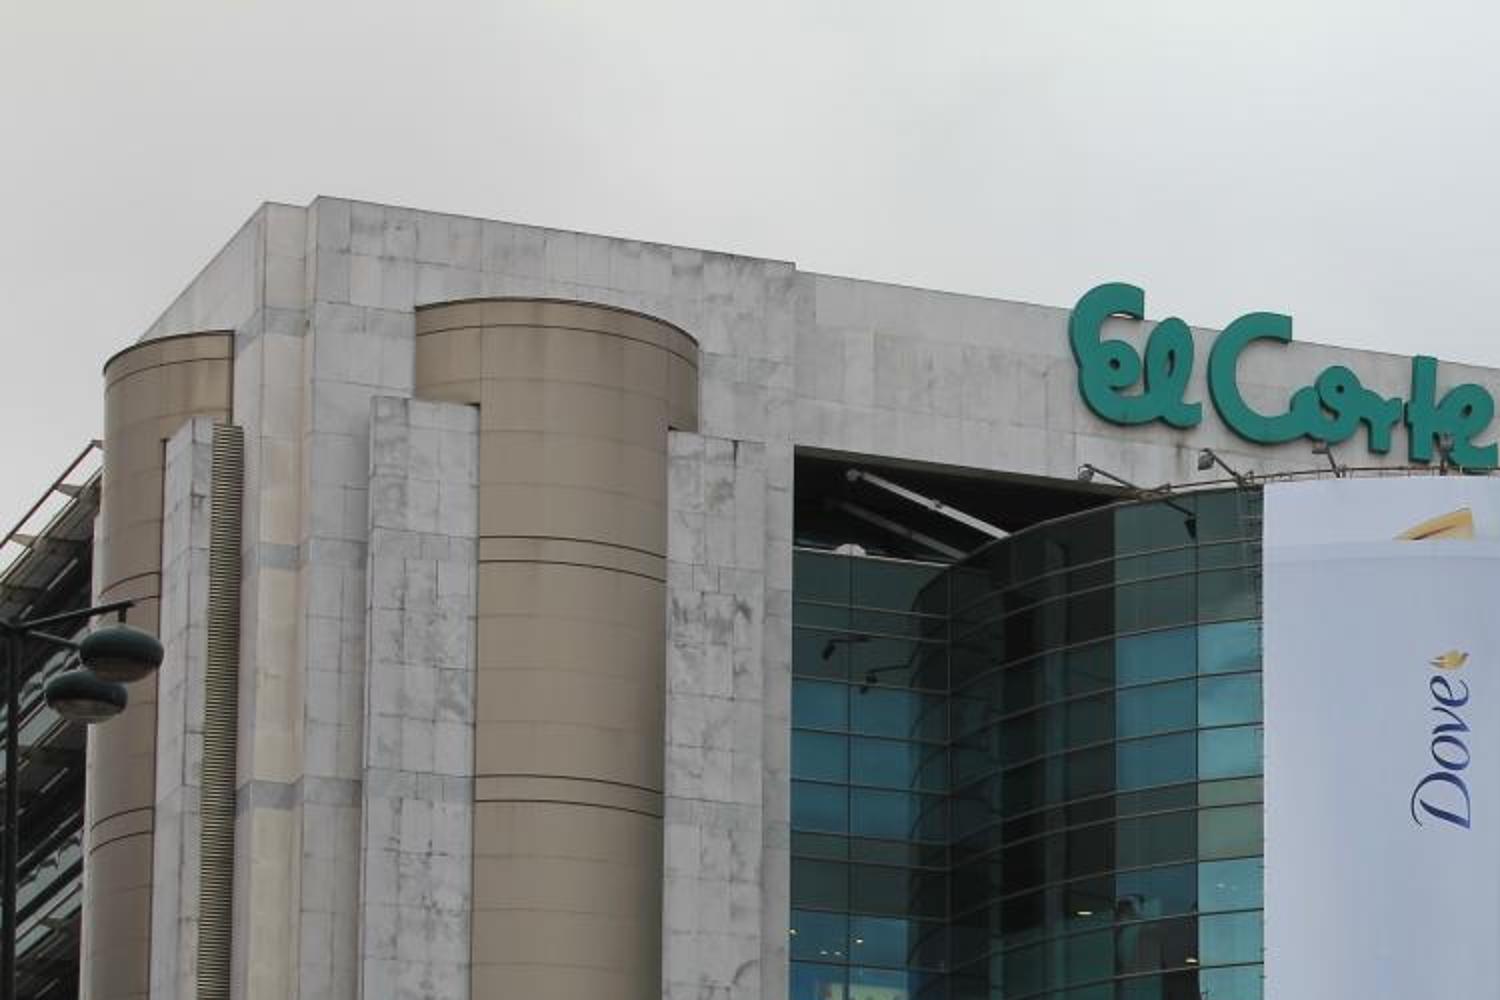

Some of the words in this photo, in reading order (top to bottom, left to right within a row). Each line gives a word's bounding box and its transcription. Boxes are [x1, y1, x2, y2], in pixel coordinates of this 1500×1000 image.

[1069, 282, 1200, 430] El
[1206, 312, 1498, 474] Corte
[1410, 674, 1471, 829] Dove
